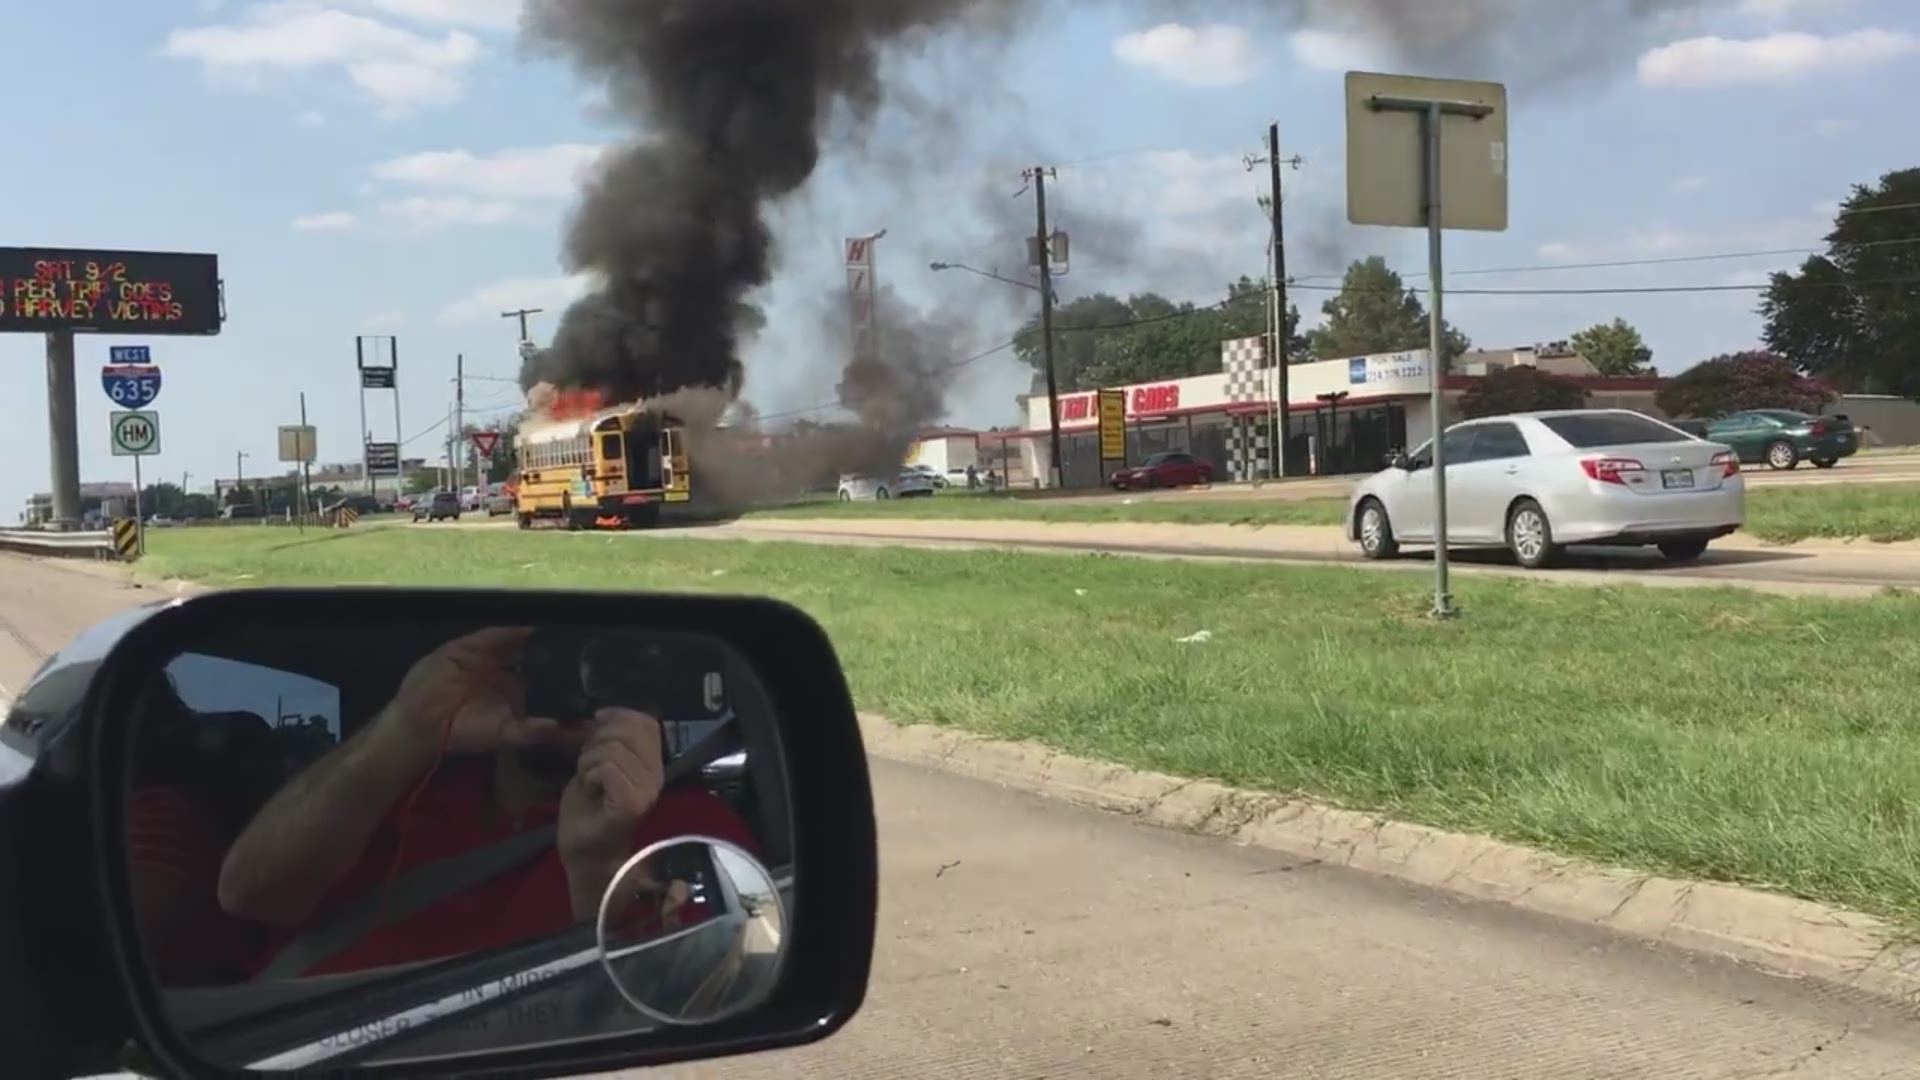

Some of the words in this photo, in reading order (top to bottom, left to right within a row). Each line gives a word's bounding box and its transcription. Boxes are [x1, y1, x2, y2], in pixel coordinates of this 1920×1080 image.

[34, 260, 75, 279] SAT
[85, 261, 126, 281] 9/2
[14, 279, 56, 299] PER
[66, 280, 108, 300] TRIP
[120, 282, 172, 301] GOES
[15, 299, 97, 318] HARVEY
[106, 300, 183, 320] VICTIMS
[114, 348, 147, 360] WEST
[111, 380, 155, 400] 635
[1133, 385, 1179, 412] CARS
[122, 424, 149, 442] HM
[320, 1017, 410, 1045] CLOSER
